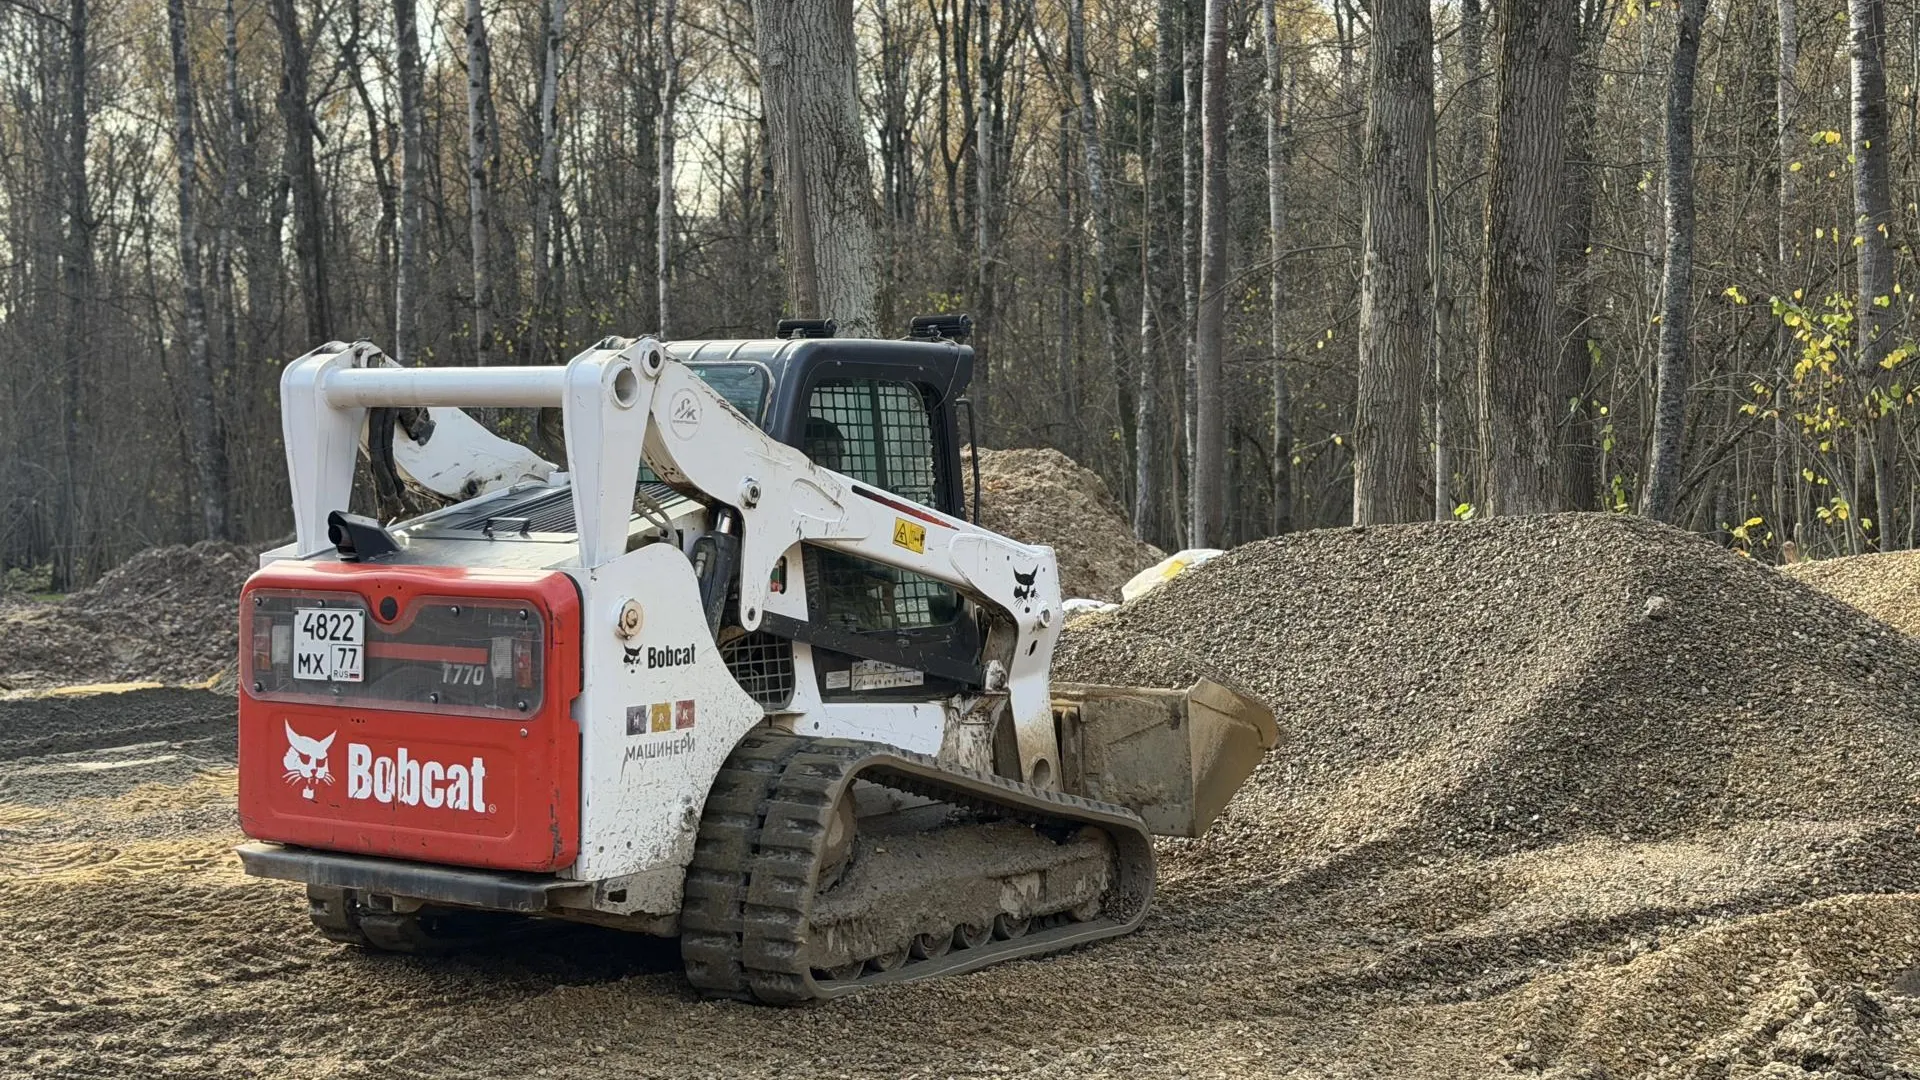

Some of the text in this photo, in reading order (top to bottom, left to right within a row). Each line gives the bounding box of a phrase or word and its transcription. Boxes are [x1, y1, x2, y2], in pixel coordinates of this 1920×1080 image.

[303, 613, 354, 641] 4822
[298, 653, 324, 675] MX
[338, 648, 357, 669] 77
[648, 643, 696, 669] Bobcat
[333, 669, 349, 679] RUS
[442, 664, 485, 685] T770
[625, 737, 696, 760] МАШИНЕРИ
[348, 743, 486, 813] Bobcat
